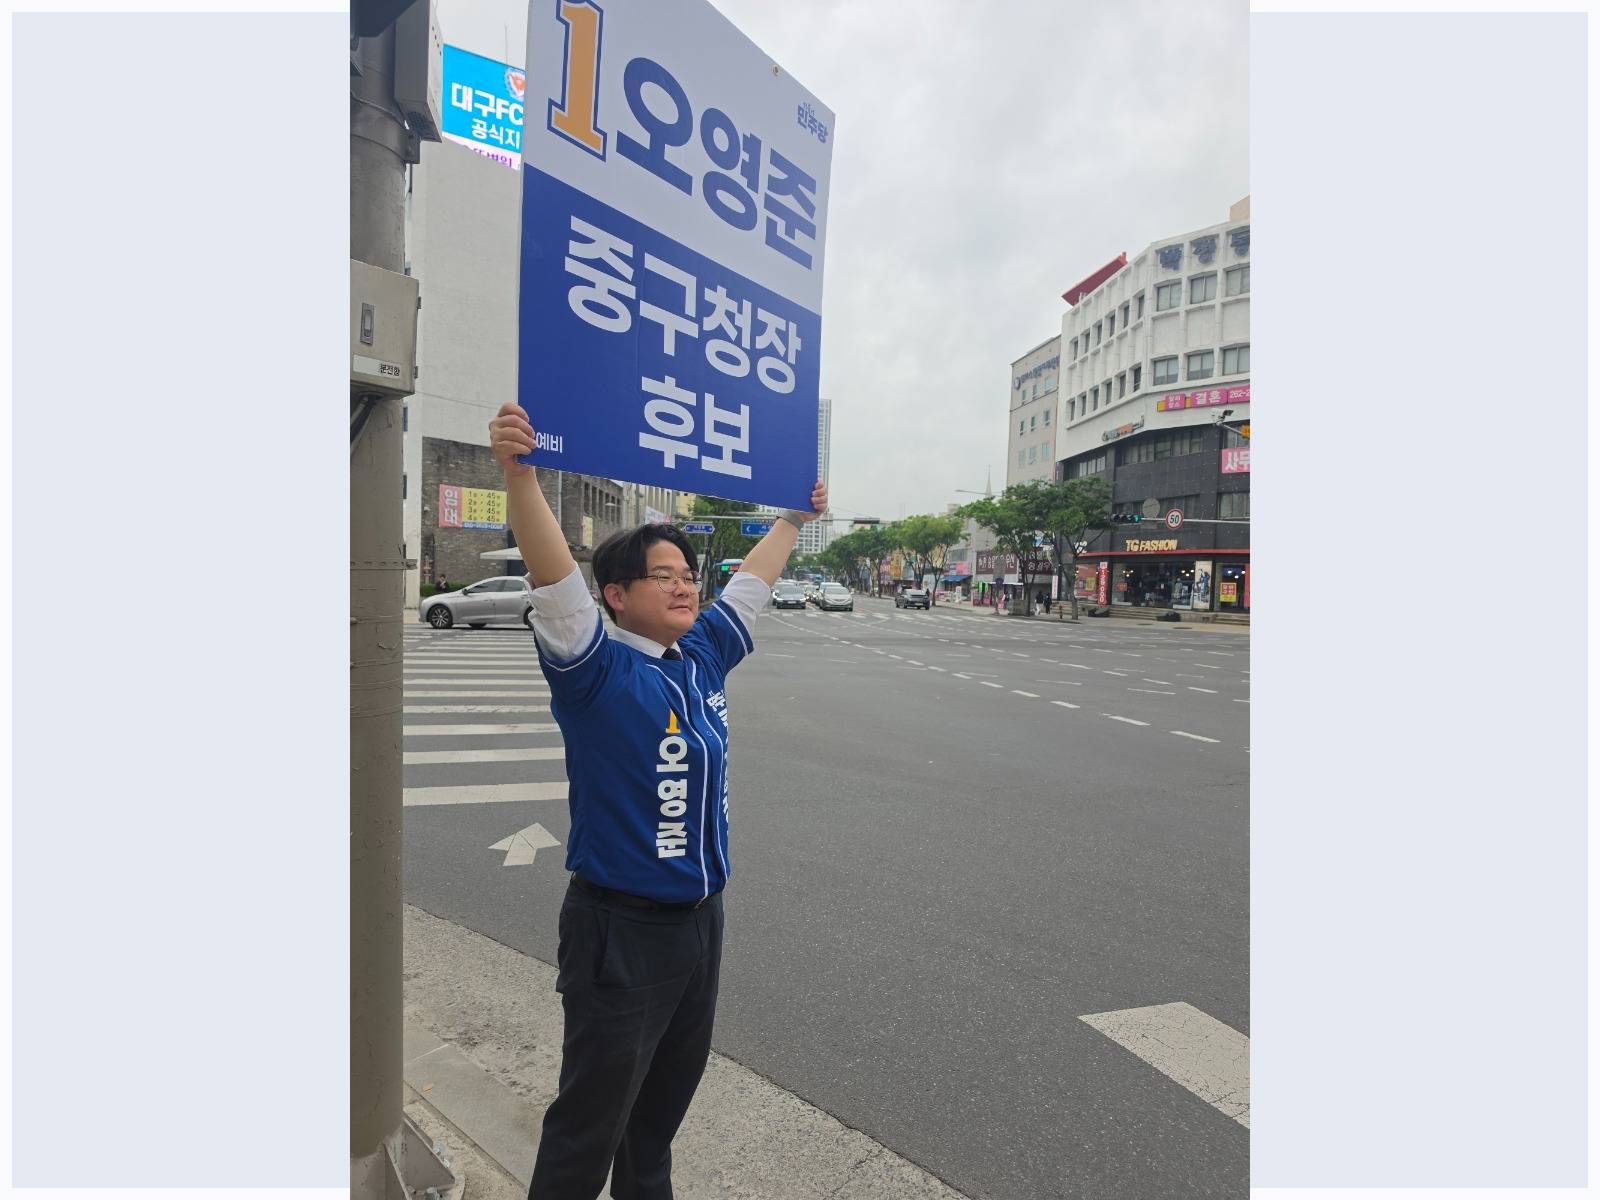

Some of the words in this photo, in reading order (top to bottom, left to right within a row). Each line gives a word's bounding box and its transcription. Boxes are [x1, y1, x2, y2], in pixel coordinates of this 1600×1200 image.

[451, 82, 524, 125] 대구FC
[797, 104, 828, 144] 민주당
[547, 0, 607, 162] 1
[616, 57, 817, 270] 오영준
[565, 216, 801, 394] 중구청장
[535, 431, 563, 454] 예비
[639, 375, 752, 479] 후보
[445, 488, 458, 524] 임대
[1170, 515, 1180, 524] 50
[1126, 539, 1140, 552] TG
[1140, 539, 1178, 551] FASHION
[656, 736, 688, 858] 오영준
